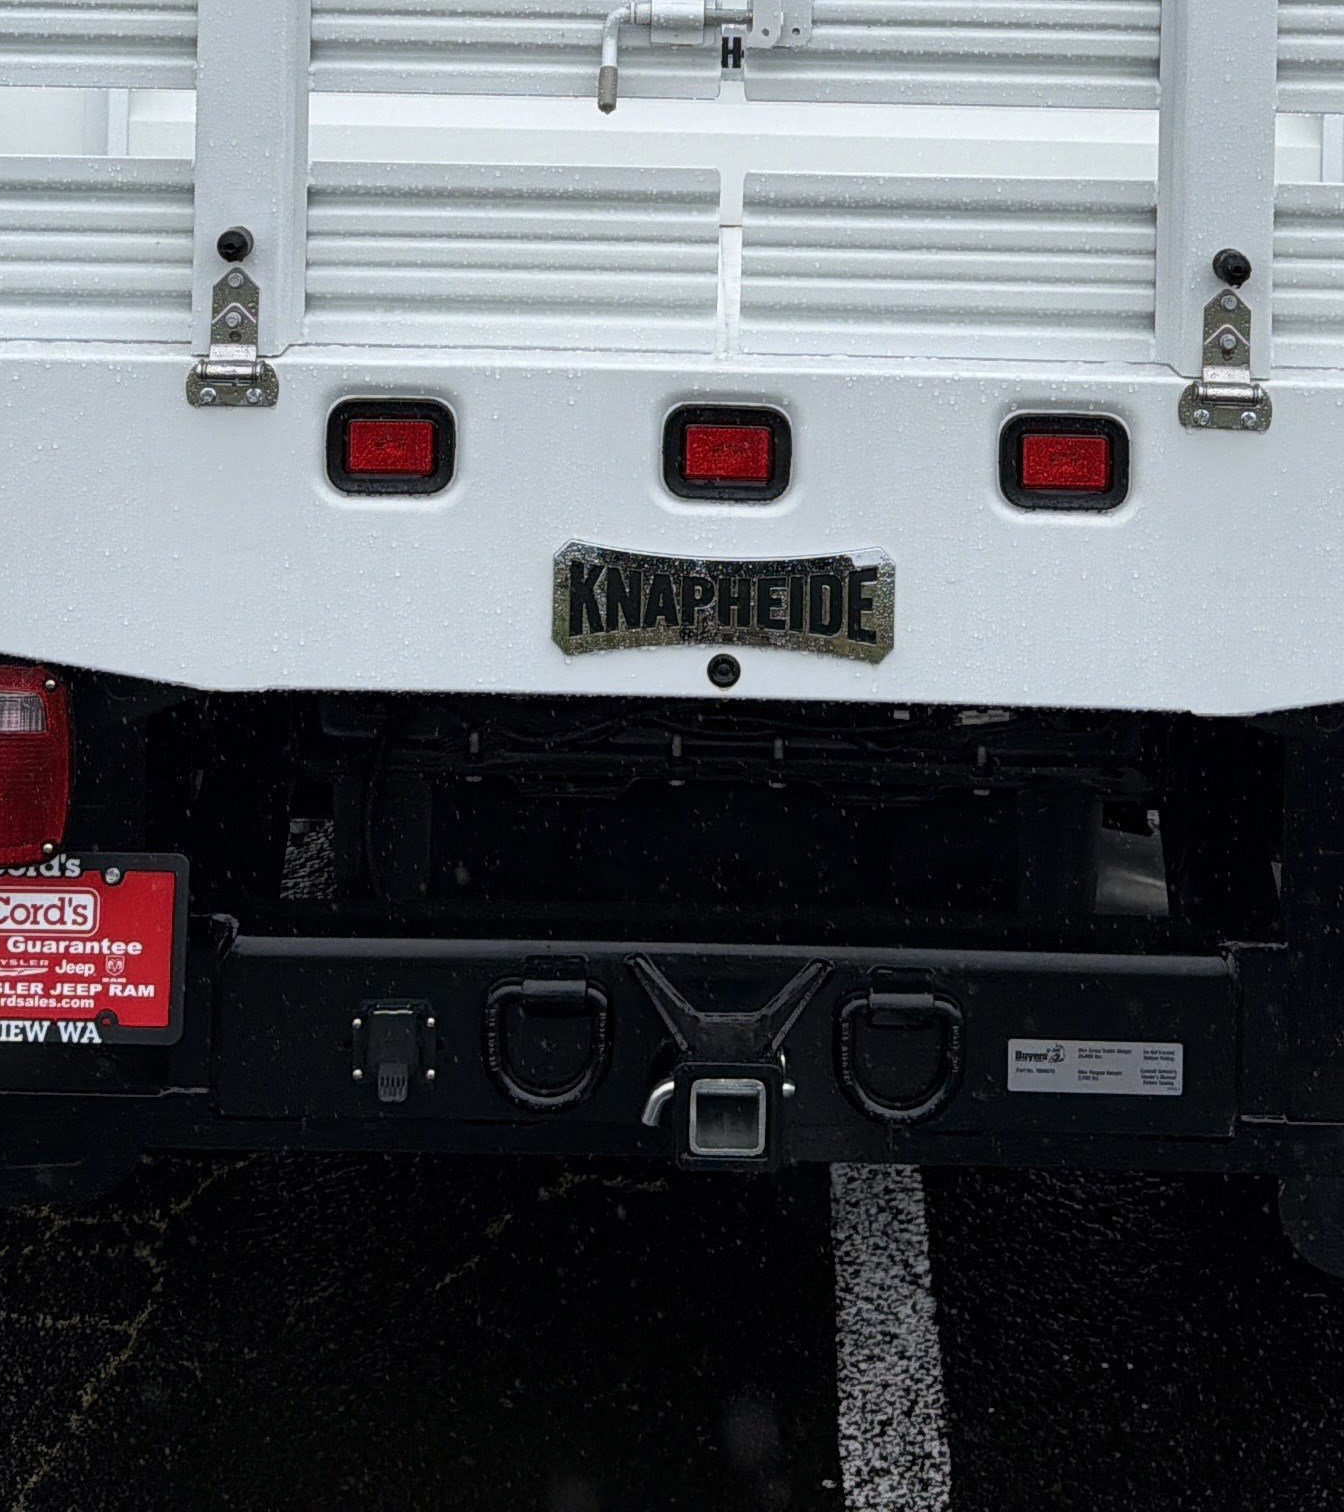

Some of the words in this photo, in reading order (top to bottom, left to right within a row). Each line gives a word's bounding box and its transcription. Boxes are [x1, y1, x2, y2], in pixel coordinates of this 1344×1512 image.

[568, 559, 880, 645] KNAPHEIDE
[7, 936, 143, 955] Guarantee
[55, 959, 96, 977] Jeep
[50, 982, 102, 997] JEEP
[109, 984, 155, 998] RAM
[57, 1020, 103, 1044] WA
[1014, 1049, 1048, 1063] Buyers
